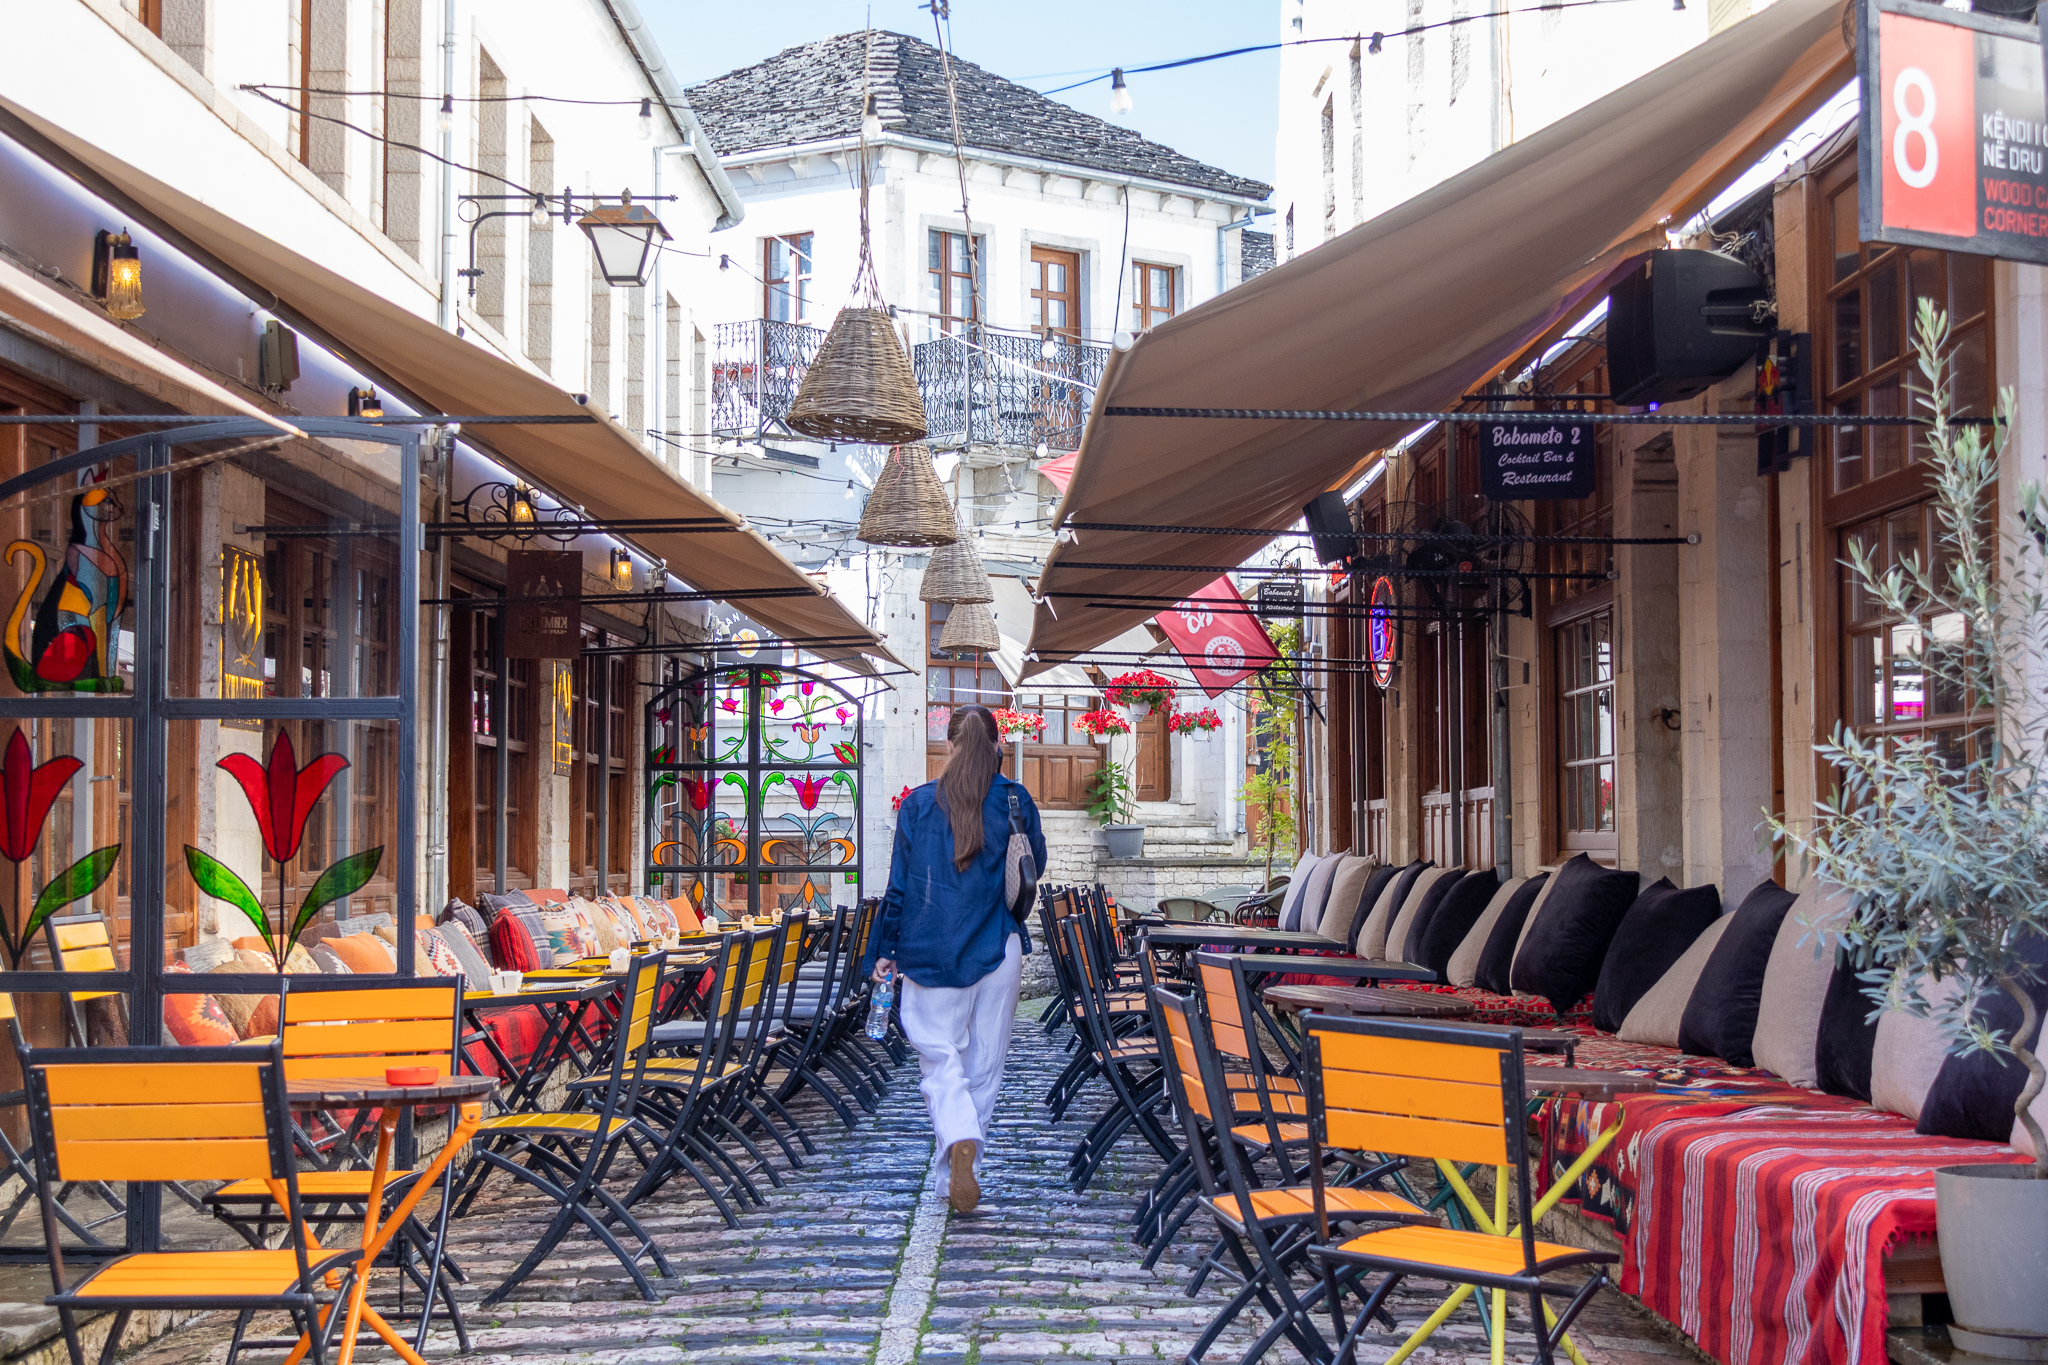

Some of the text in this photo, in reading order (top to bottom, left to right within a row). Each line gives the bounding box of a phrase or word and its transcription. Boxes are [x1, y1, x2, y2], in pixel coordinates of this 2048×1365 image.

[1893, 67, 1939, 189] 8
[1983, 109, 2031, 145] KËNDI
[1983, 139, 2042, 174] NË DRU
[1983, 177, 2032, 207] WOOD
[1983, 206, 2048, 238] CORNER
[1492, 426, 1581, 447] Babameto 2
[1498, 451, 1574, 467] Cocktail Bar &
[1502, 470, 1573, 486] Restaurant
[1294, 589, 1300, 597] 2
